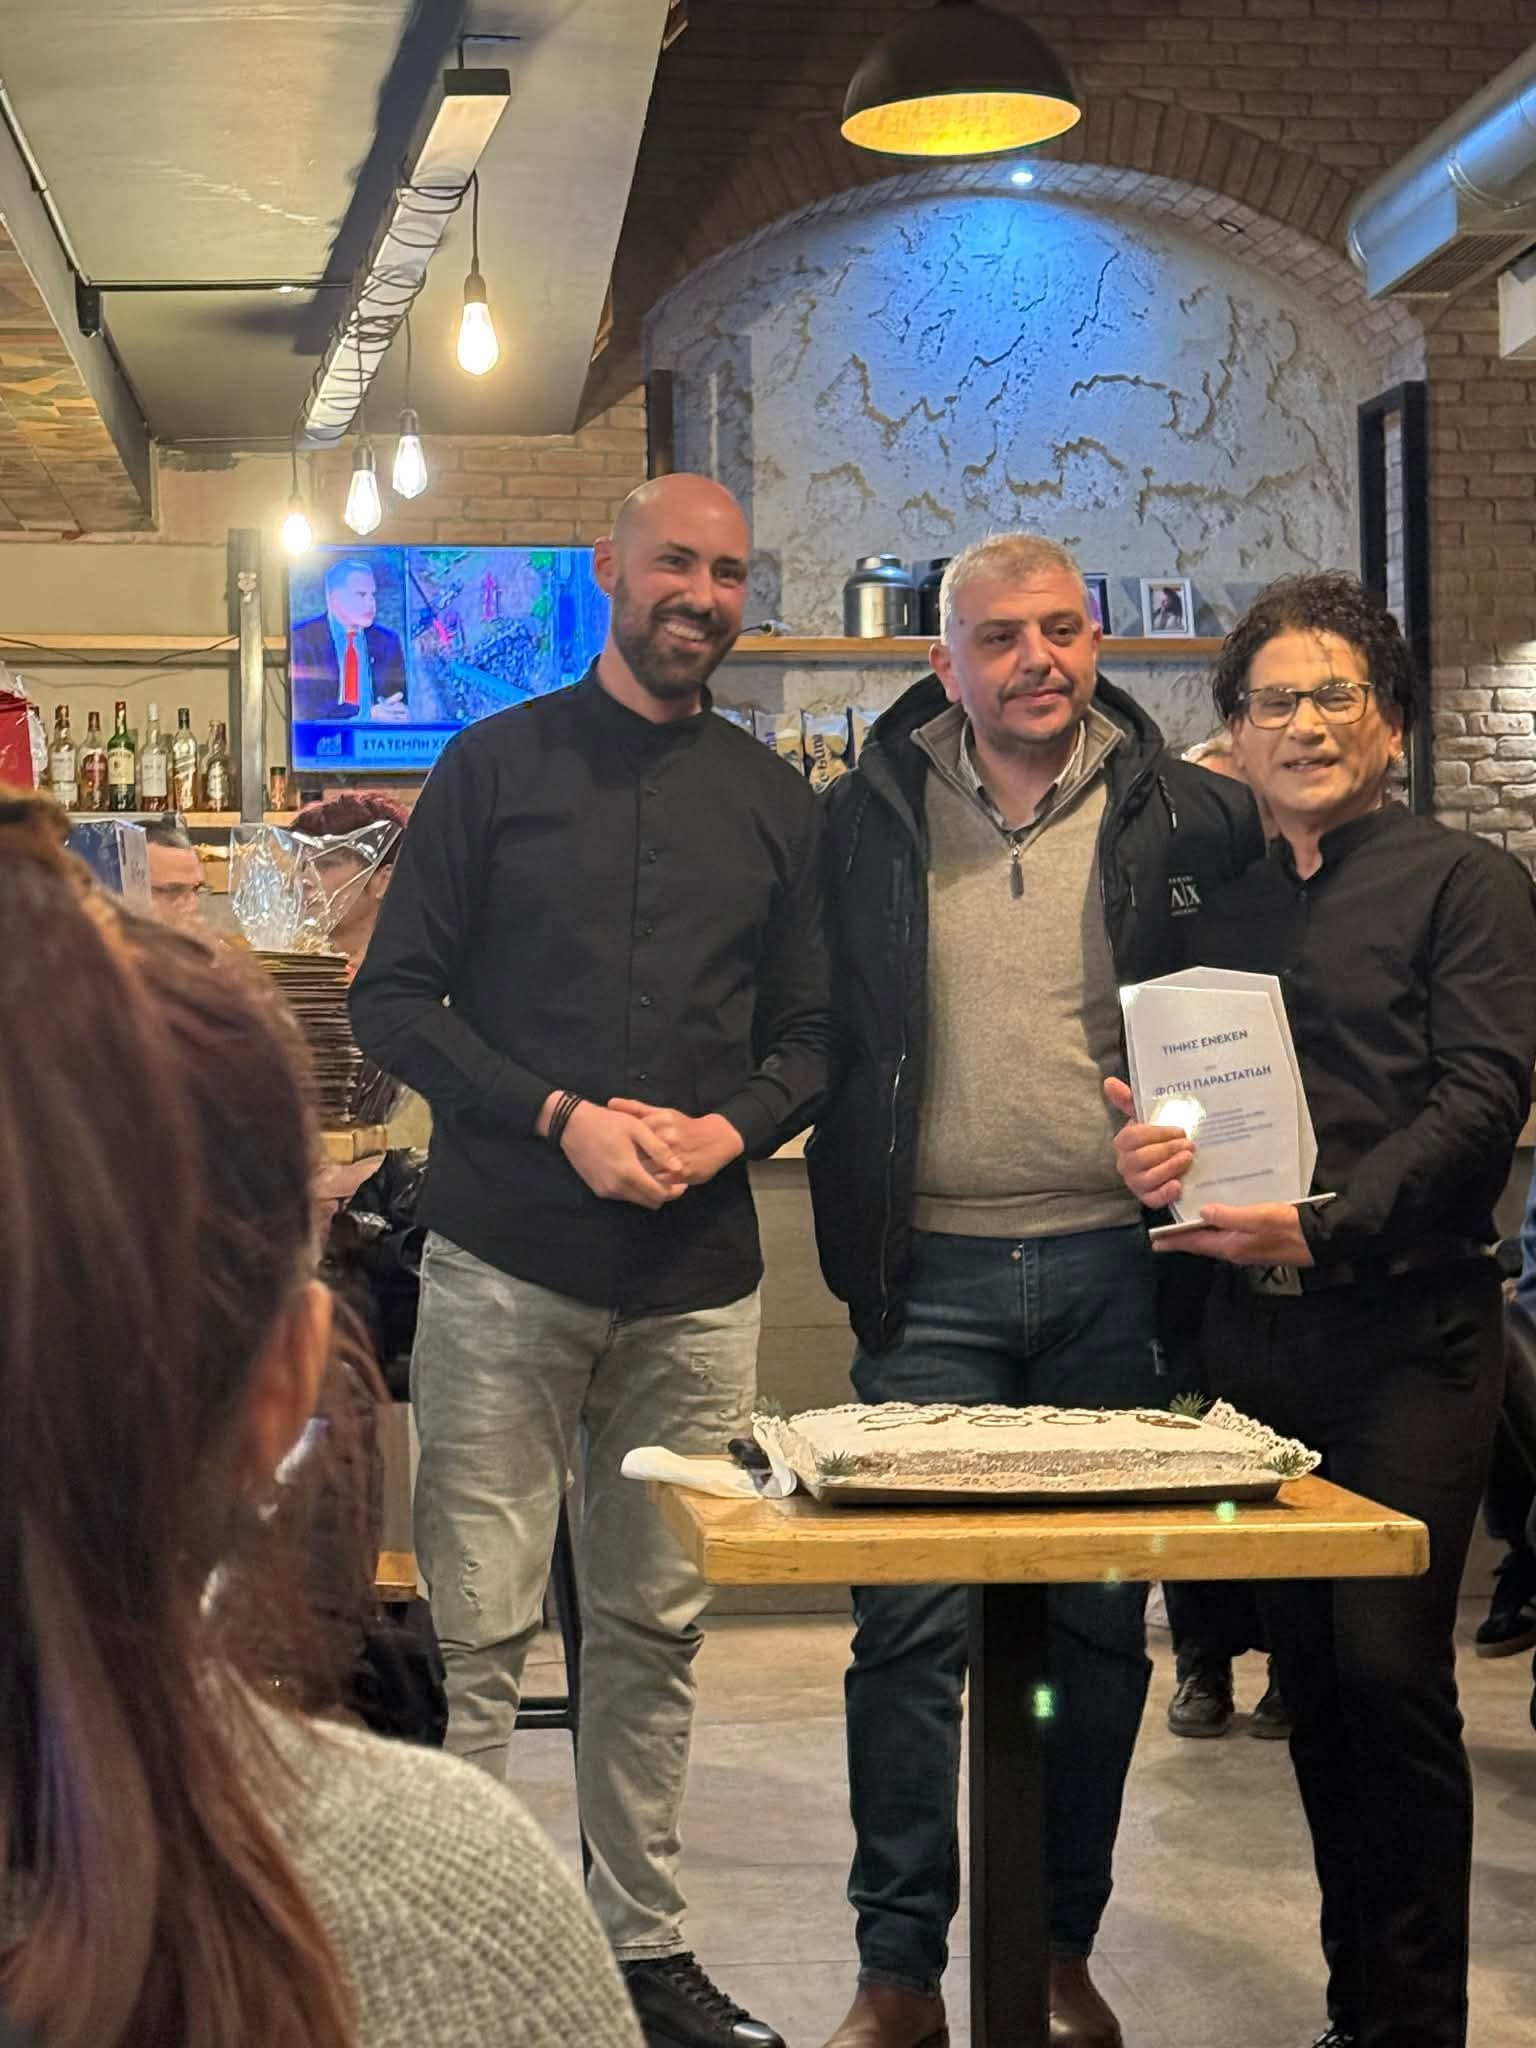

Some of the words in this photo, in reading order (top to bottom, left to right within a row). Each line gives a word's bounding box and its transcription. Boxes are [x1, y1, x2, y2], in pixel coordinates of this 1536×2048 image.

[387, 738, 430, 751] ΤΕΜΠΗ
[1161, 1039, 1200, 1056] ΤΙΜΗΣ
[1201, 1029, 1249, 1048] ΕΝΕΚΕΝ
[1193, 1064, 1272, 1090] ΠΑΡΑΣΤΑΤΙΔΗ
